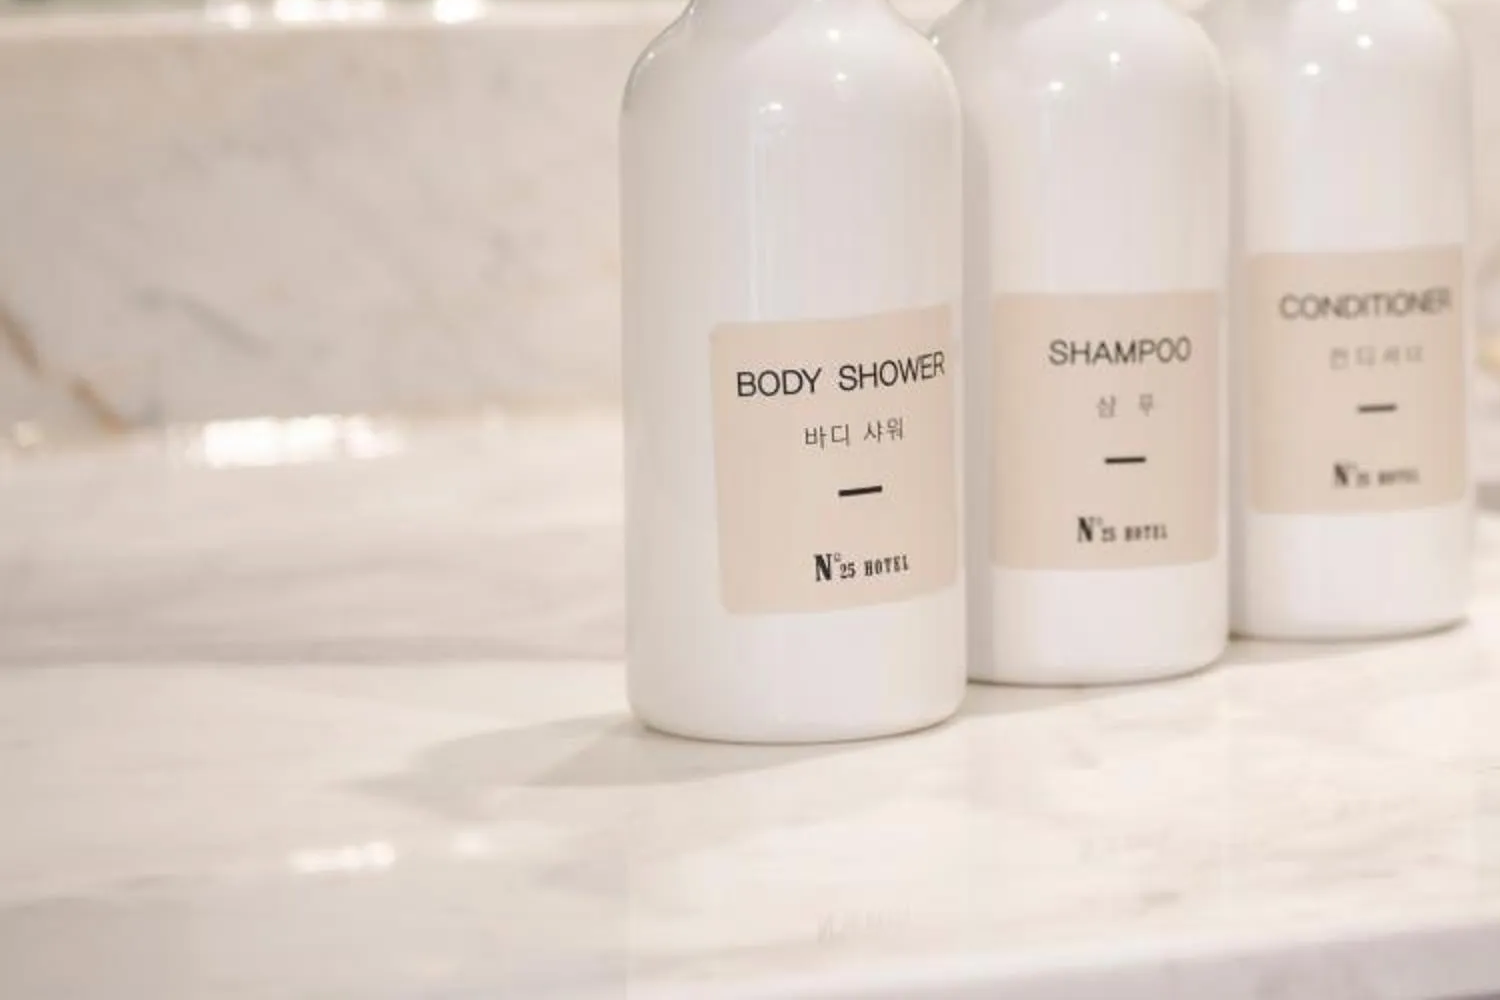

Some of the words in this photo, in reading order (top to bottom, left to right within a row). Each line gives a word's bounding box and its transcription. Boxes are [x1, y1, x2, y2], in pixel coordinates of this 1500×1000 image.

[1048, 335, 1192, 366] SHAMPOO
[736, 367, 823, 398] BODY
[838, 350, 945, 392] SHOWER
[804, 423, 850, 450] 바디
[863, 417, 904, 443] 샤워
[863, 554, 909, 577] HOTEL
